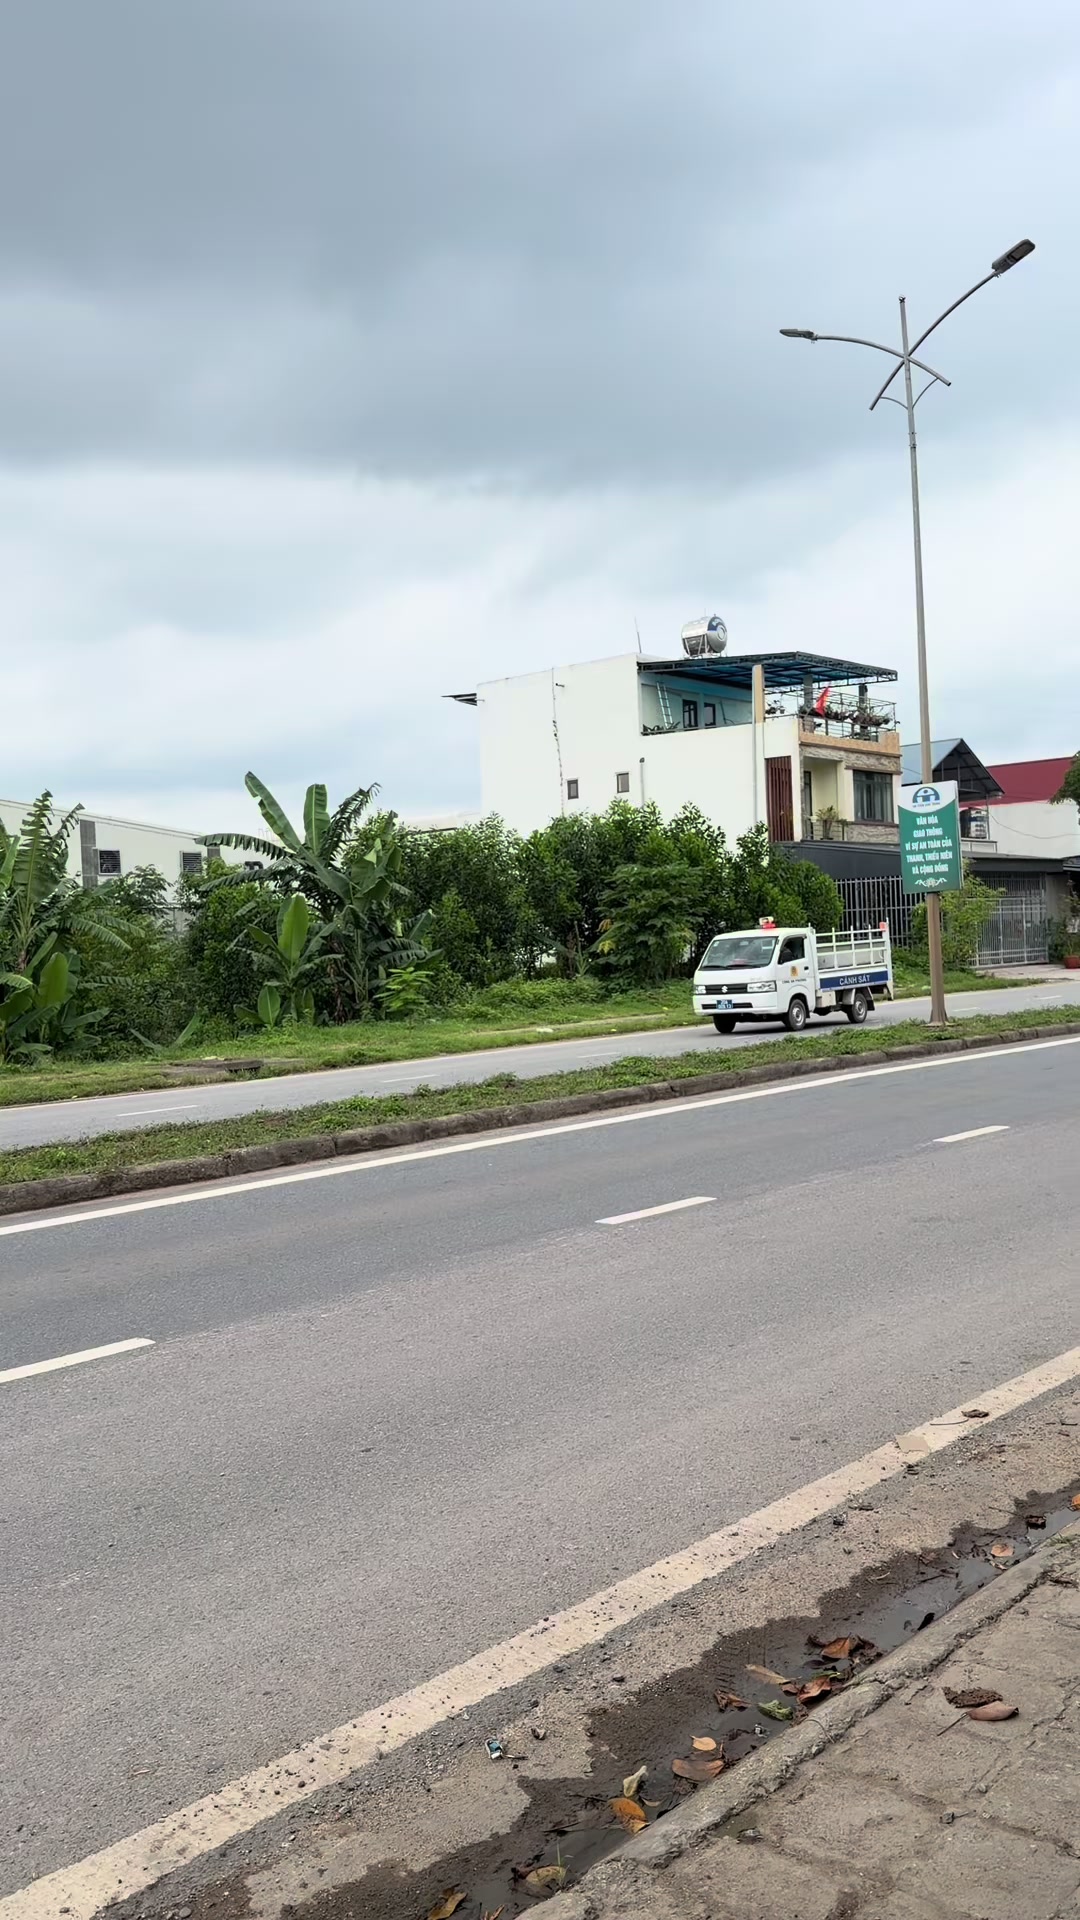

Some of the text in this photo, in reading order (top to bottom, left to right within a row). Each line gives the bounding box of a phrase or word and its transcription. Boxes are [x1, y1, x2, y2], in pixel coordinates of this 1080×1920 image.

[919, 841, 927, 849] AN
[941, 836, 952, 847] CỦA
[858, 974, 870, 983] SÁT
